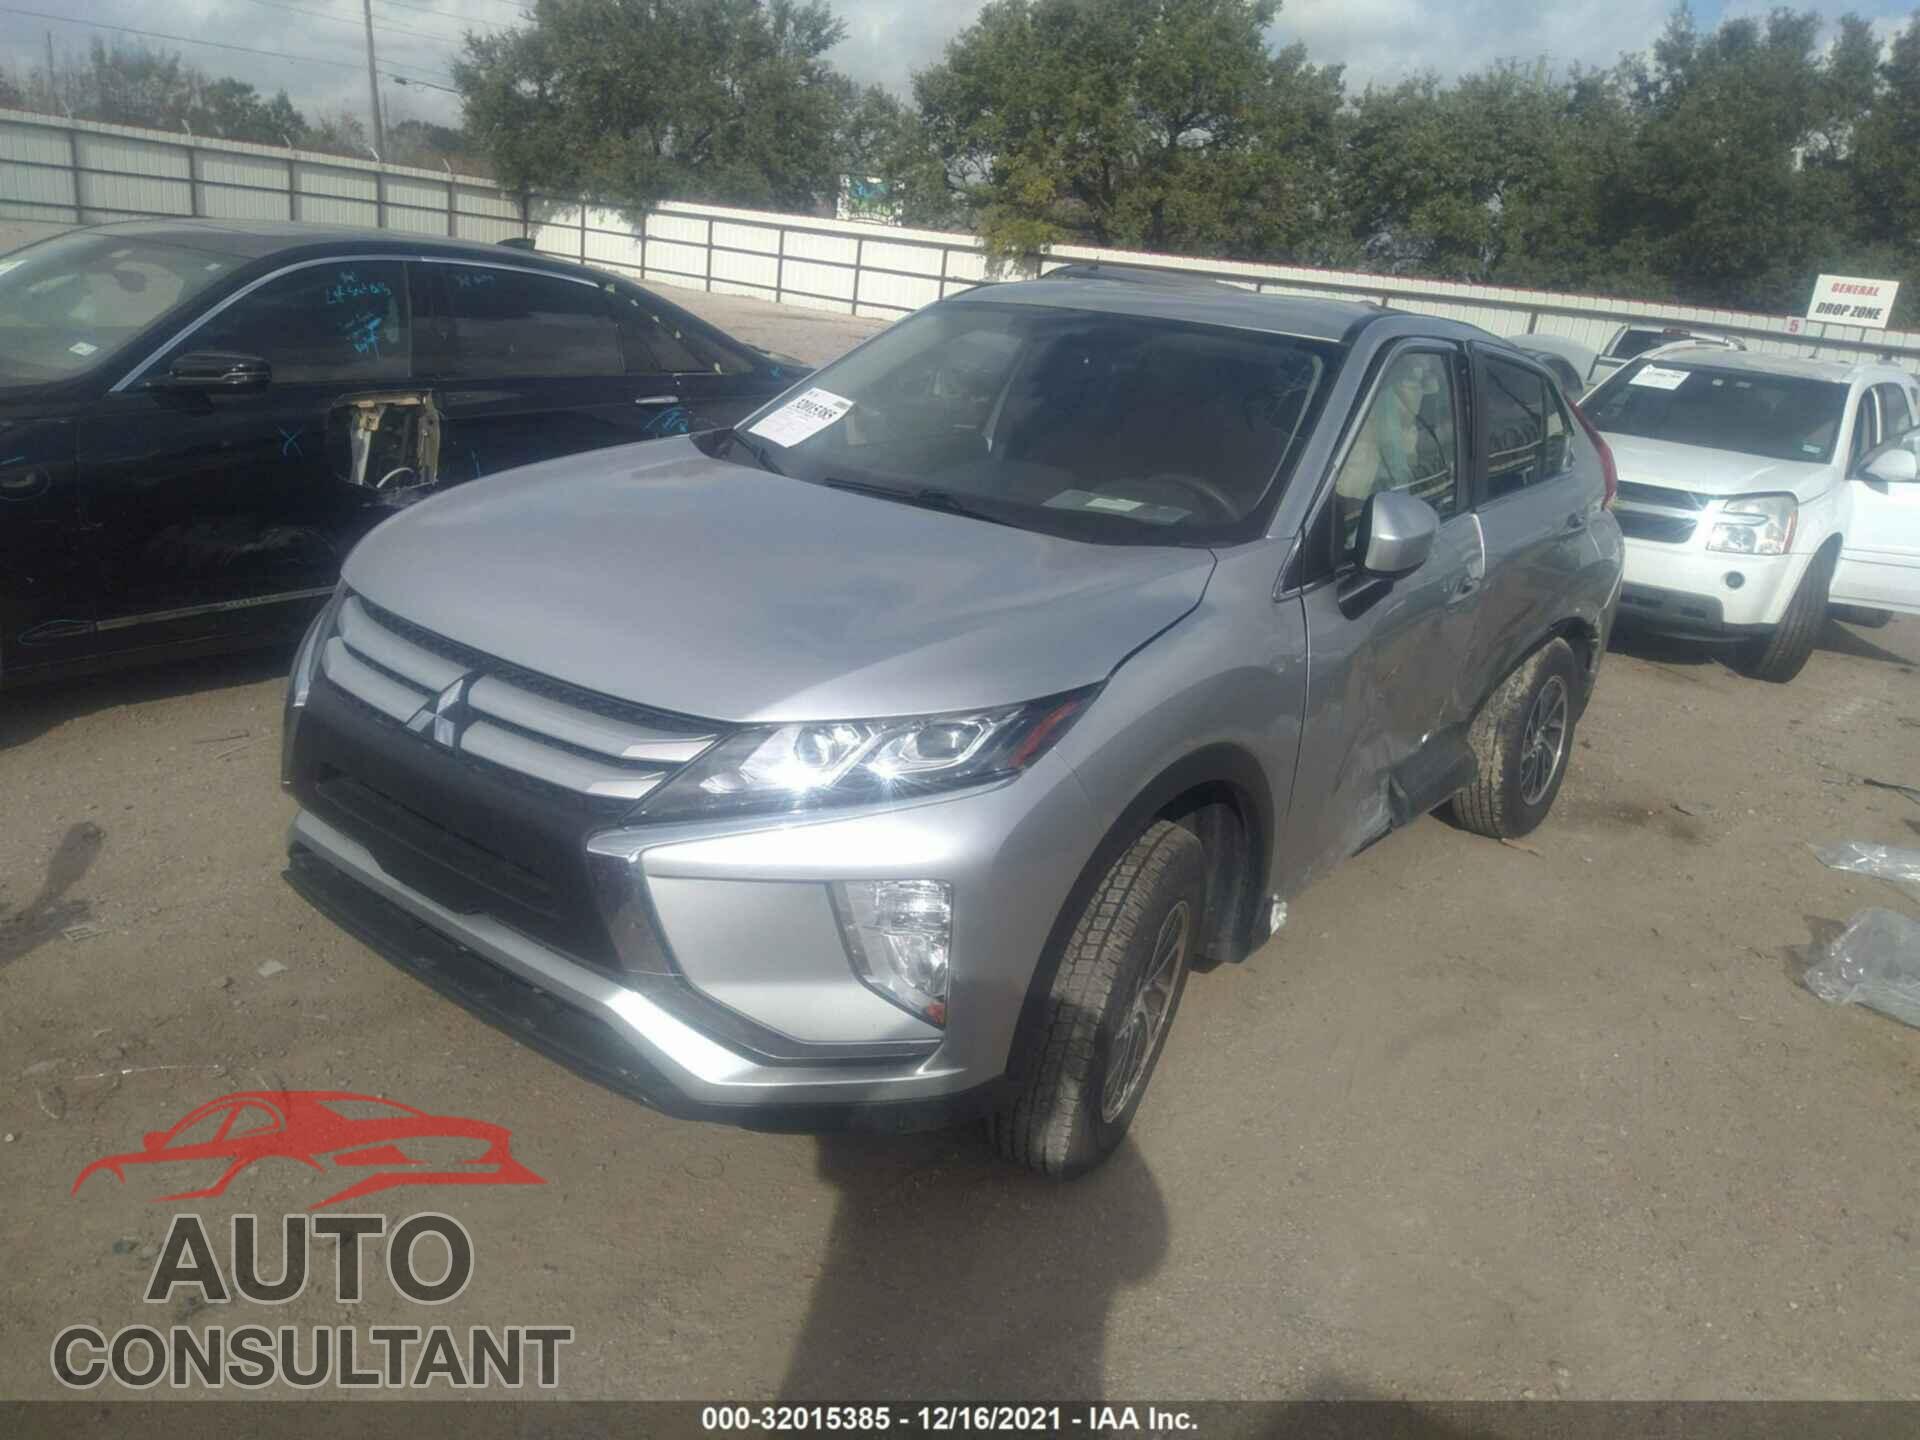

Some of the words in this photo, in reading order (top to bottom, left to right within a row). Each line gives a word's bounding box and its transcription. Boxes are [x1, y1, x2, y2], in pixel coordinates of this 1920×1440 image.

[1831, 283, 1880, 296] GENERAL
[1815, 302, 1850, 316] DROP
[1850, 305, 1883, 319] ZONE
